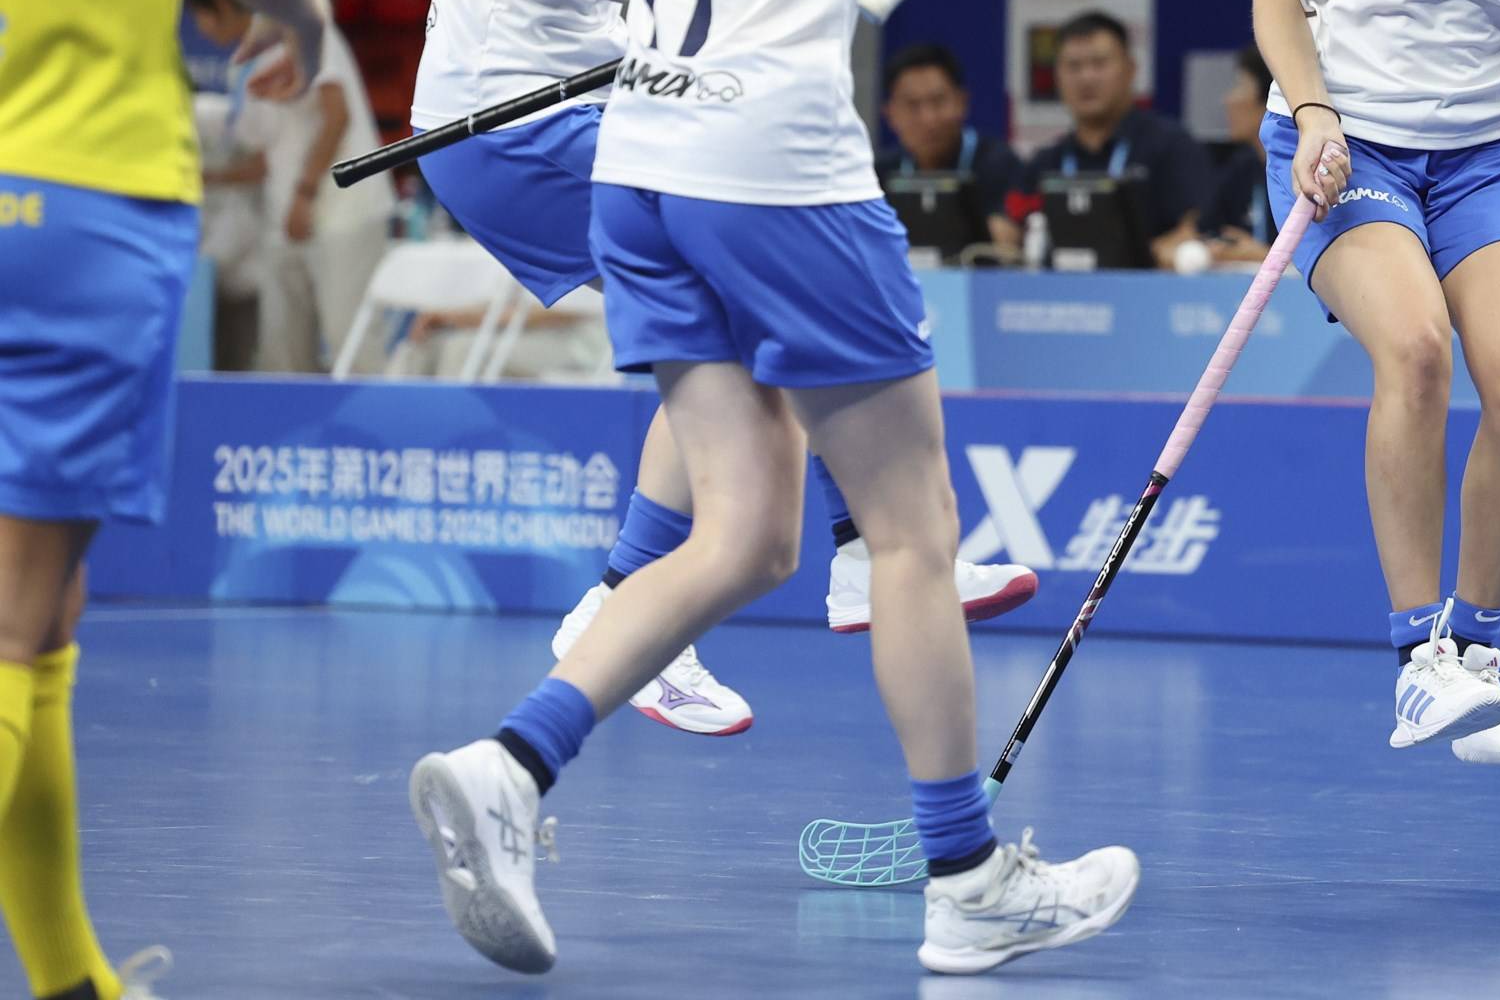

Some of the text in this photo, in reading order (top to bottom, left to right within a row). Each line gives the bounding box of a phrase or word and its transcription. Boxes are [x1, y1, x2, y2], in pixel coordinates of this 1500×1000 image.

[214, 445, 618, 508] 2025年第12届世界运动会
[212, 502, 620, 551] THE WORLD GAMES 2025 CHENGDU
